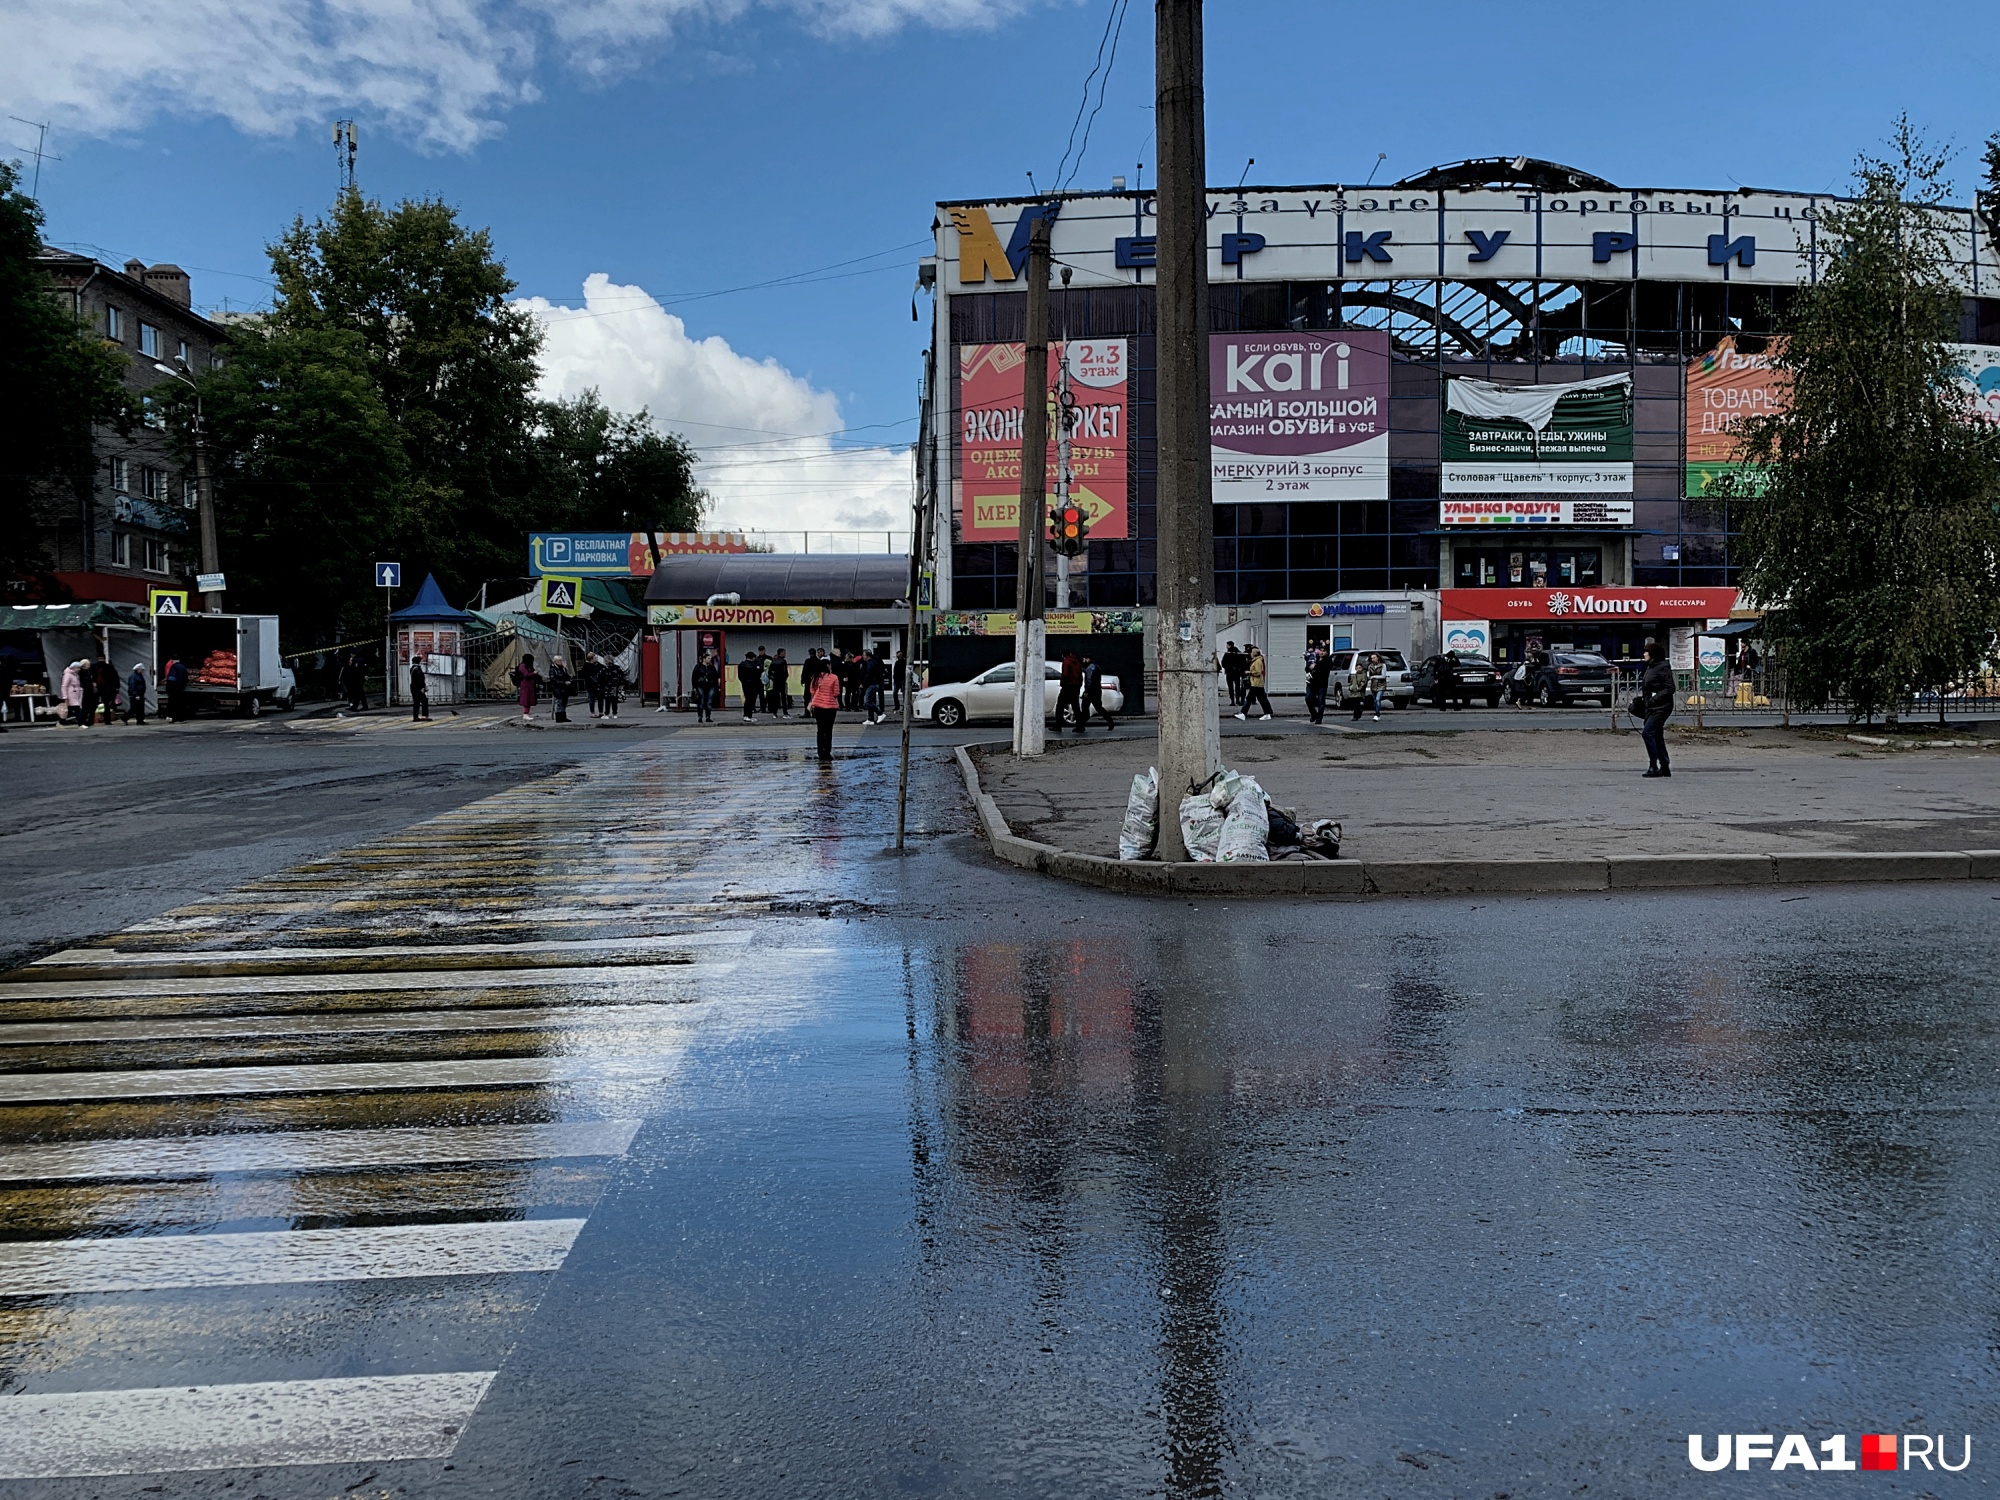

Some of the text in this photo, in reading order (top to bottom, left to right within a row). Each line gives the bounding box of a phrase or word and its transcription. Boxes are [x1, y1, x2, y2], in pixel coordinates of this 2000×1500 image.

[1517, 194, 1740, 217] Торговый
[945, 202, 1755, 284] МЕРКУРИ
[1244, 342, 1322, 352] ЕСЛИ ОБУВЬ, ТО
[1080, 345, 1120, 364] 2 и 3
[1080, 366, 1120, 377] этаж
[1227, 341, 1351, 393] kari
[1210, 396, 1377, 419] АМЫЙ БОЛЬШОЙ
[1268, 418, 1335, 435] ОБУВИ
[1338, 424, 1346, 433] В
[1349, 422, 1375, 433] УФЕ
[1468, 431, 1607, 442] ЗАВТРАКИ, ОЕДЫ, УЖИНЫ
[1070, 446, 1115, 460] БУВЬ
[1469, 443, 1607, 454] Бизнес-ланчи, вежая выпечка
[1700, 444, 1716, 456] на
[1213, 461, 1364, 477] МЕРКУРИЙ 3 корпус
[1265, 479, 1310, 490] 2 этаж
[1448, 473, 1495, 482] Столовая
[1549, 473, 1554, 482] 1
[1556, 474, 1592, 484] корпус,
[1594, 473, 1601, 482] 3
[1603, 473, 1627, 482] этаж
[1090, 502, 1099, 518] 2
[574, 540, 626, 550] БЕСПЛАТНАЯ
[574, 553, 618, 563] ПАРКОВКА
[1573, 595, 1648, 613] Monro
[1659, 599, 1707, 607] АКСЕССУАРЫ
[696, 608, 775, 624] ШАУРМА
